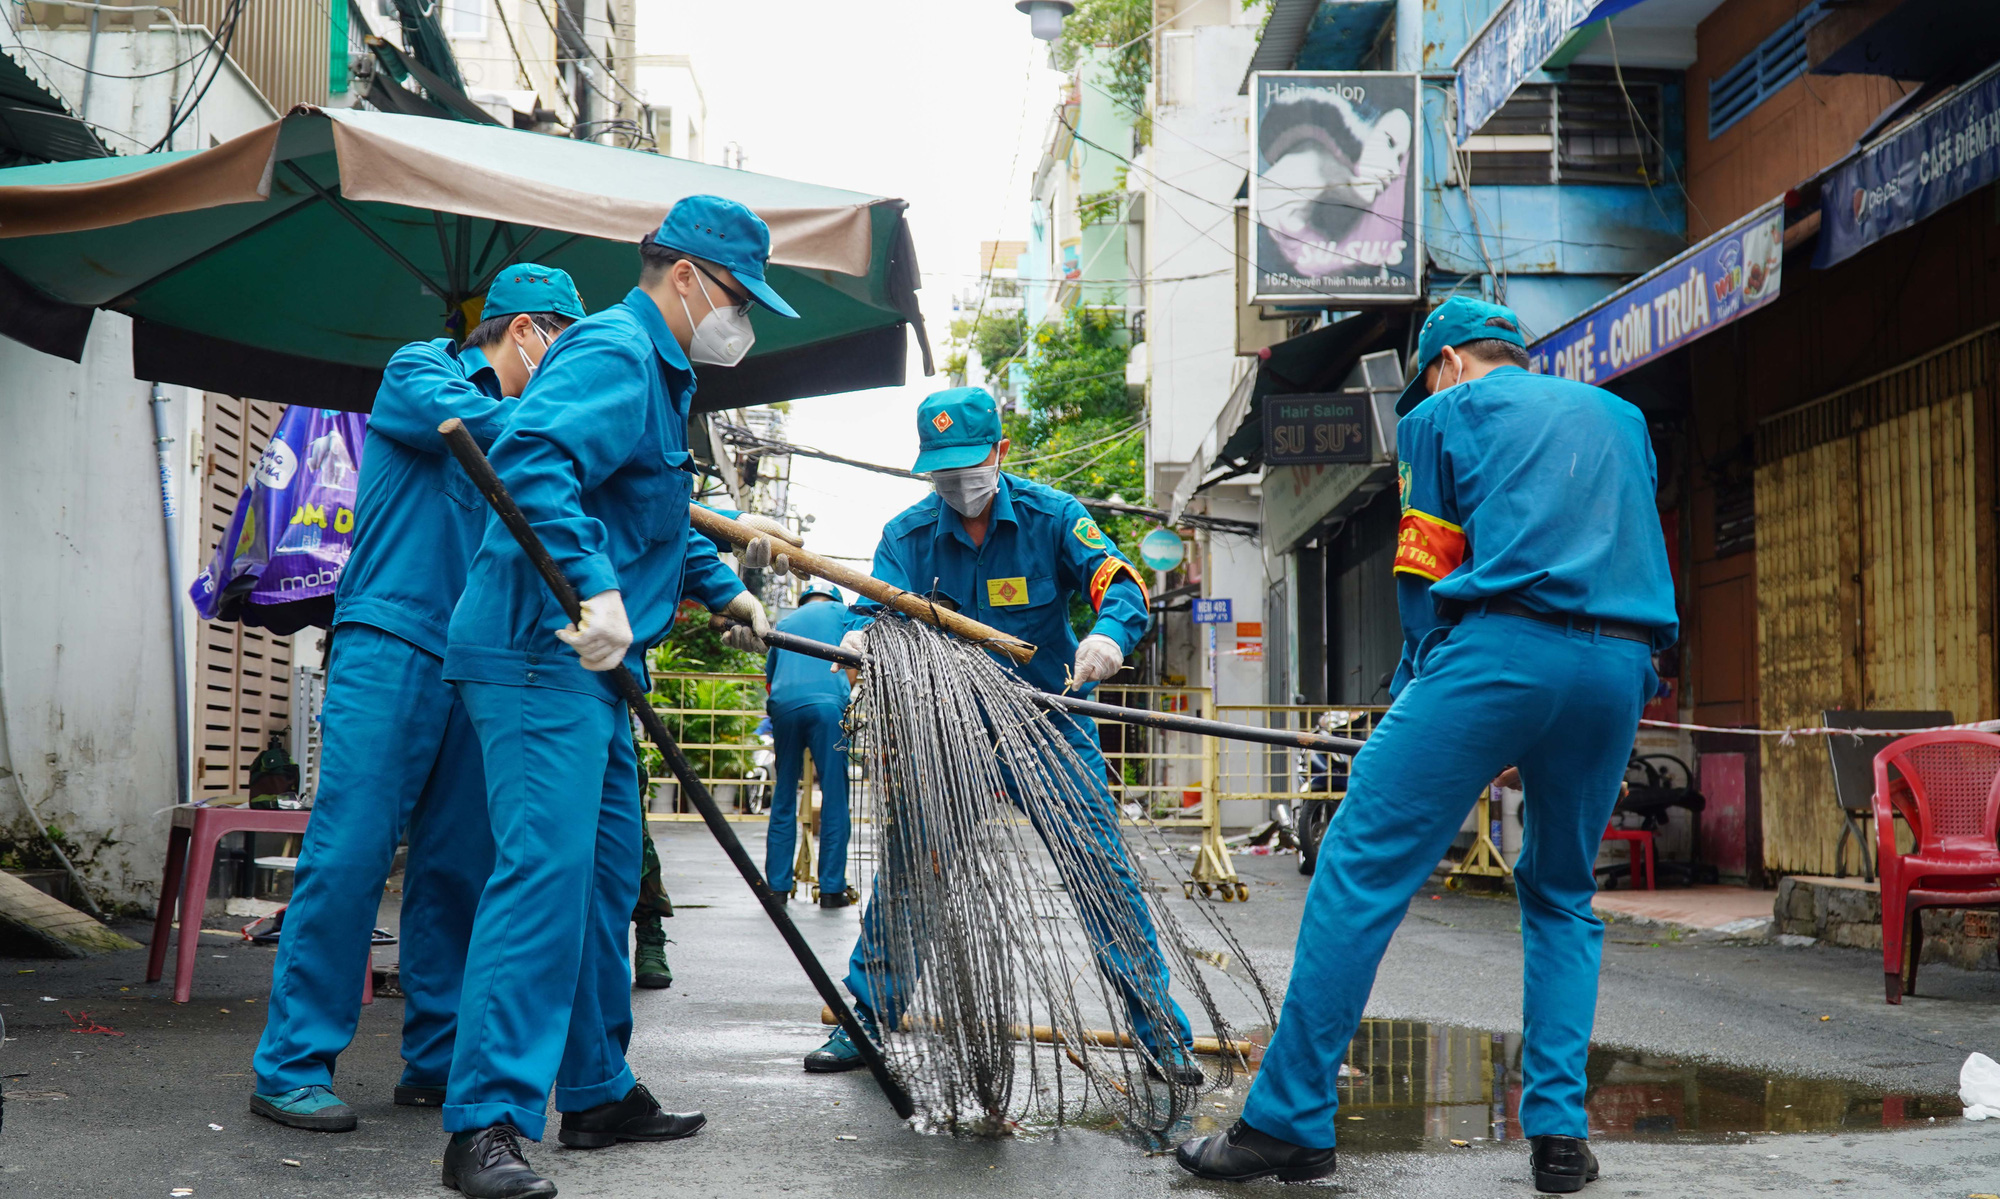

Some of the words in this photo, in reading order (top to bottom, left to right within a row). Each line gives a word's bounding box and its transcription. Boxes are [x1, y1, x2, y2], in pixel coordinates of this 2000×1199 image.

[1989, 107, 2000, 147] H
[1264, 272, 1288, 287] 16/2
[1555, 321, 1597, 383] CAFÉ
[1610, 303, 1651, 370] CƠM
[1654, 267, 1710, 348] TRƯA
[1281, 405, 1309, 418] Hair
[1313, 404, 1354, 416] Salon
[1274, 425, 1305, 454] SU
[1314, 423, 1362, 453] SU'S
[1410, 546, 1437, 569] TRA
[280, 566, 342, 592] mobif
